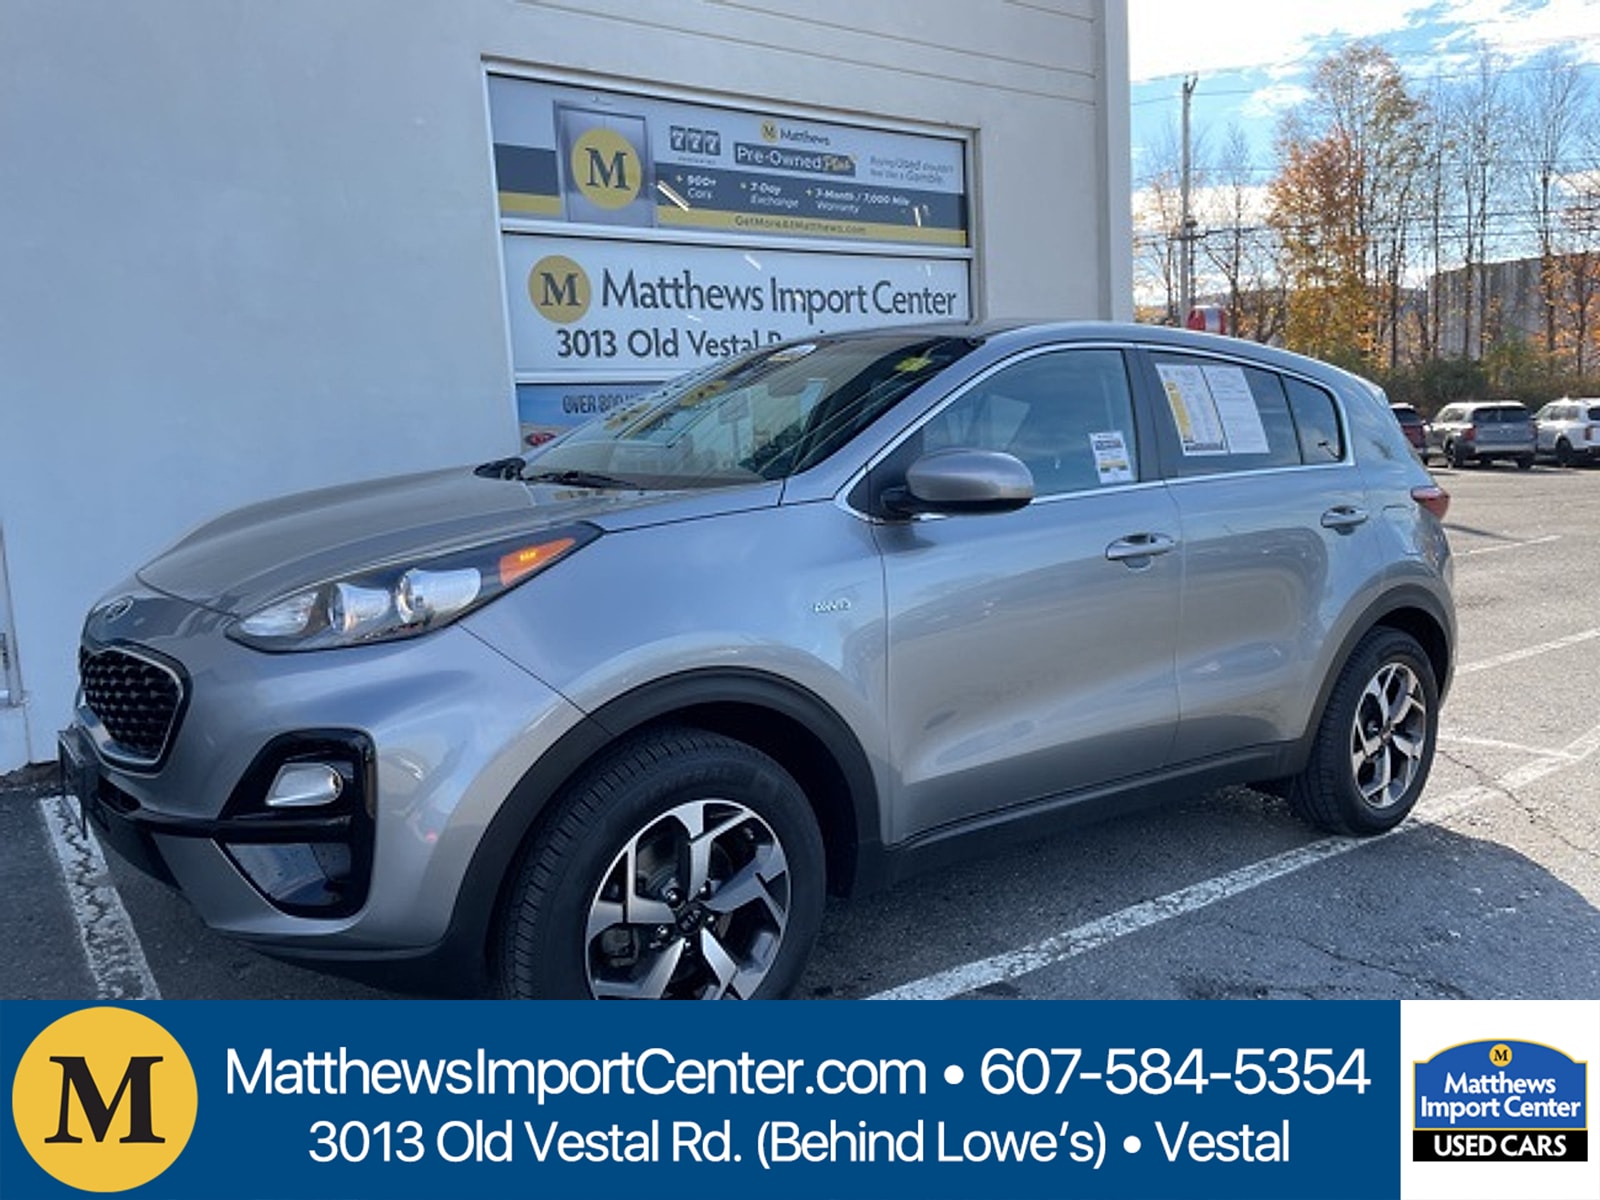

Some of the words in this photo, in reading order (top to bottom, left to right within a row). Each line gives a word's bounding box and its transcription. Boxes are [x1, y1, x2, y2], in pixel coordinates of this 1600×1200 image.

[779, 128, 831, 146] Matthews
[585, 147, 631, 190] M
[736, 145, 821, 170] Pre-Owned
[686, 188, 713, 200] Cars
[750, 195, 799, 209] Exchange
[816, 200, 861, 214] Warranty
[540, 272, 581, 306] M
[602, 267, 764, 312] Matthews
[770, 277, 868, 325] Import
[872, 280, 957, 315] Center
[556, 328, 618, 358] 3013
[627, 327, 679, 358] Old
[686, 328, 759, 357] Vestal
[562, 395, 596, 414] OVER
